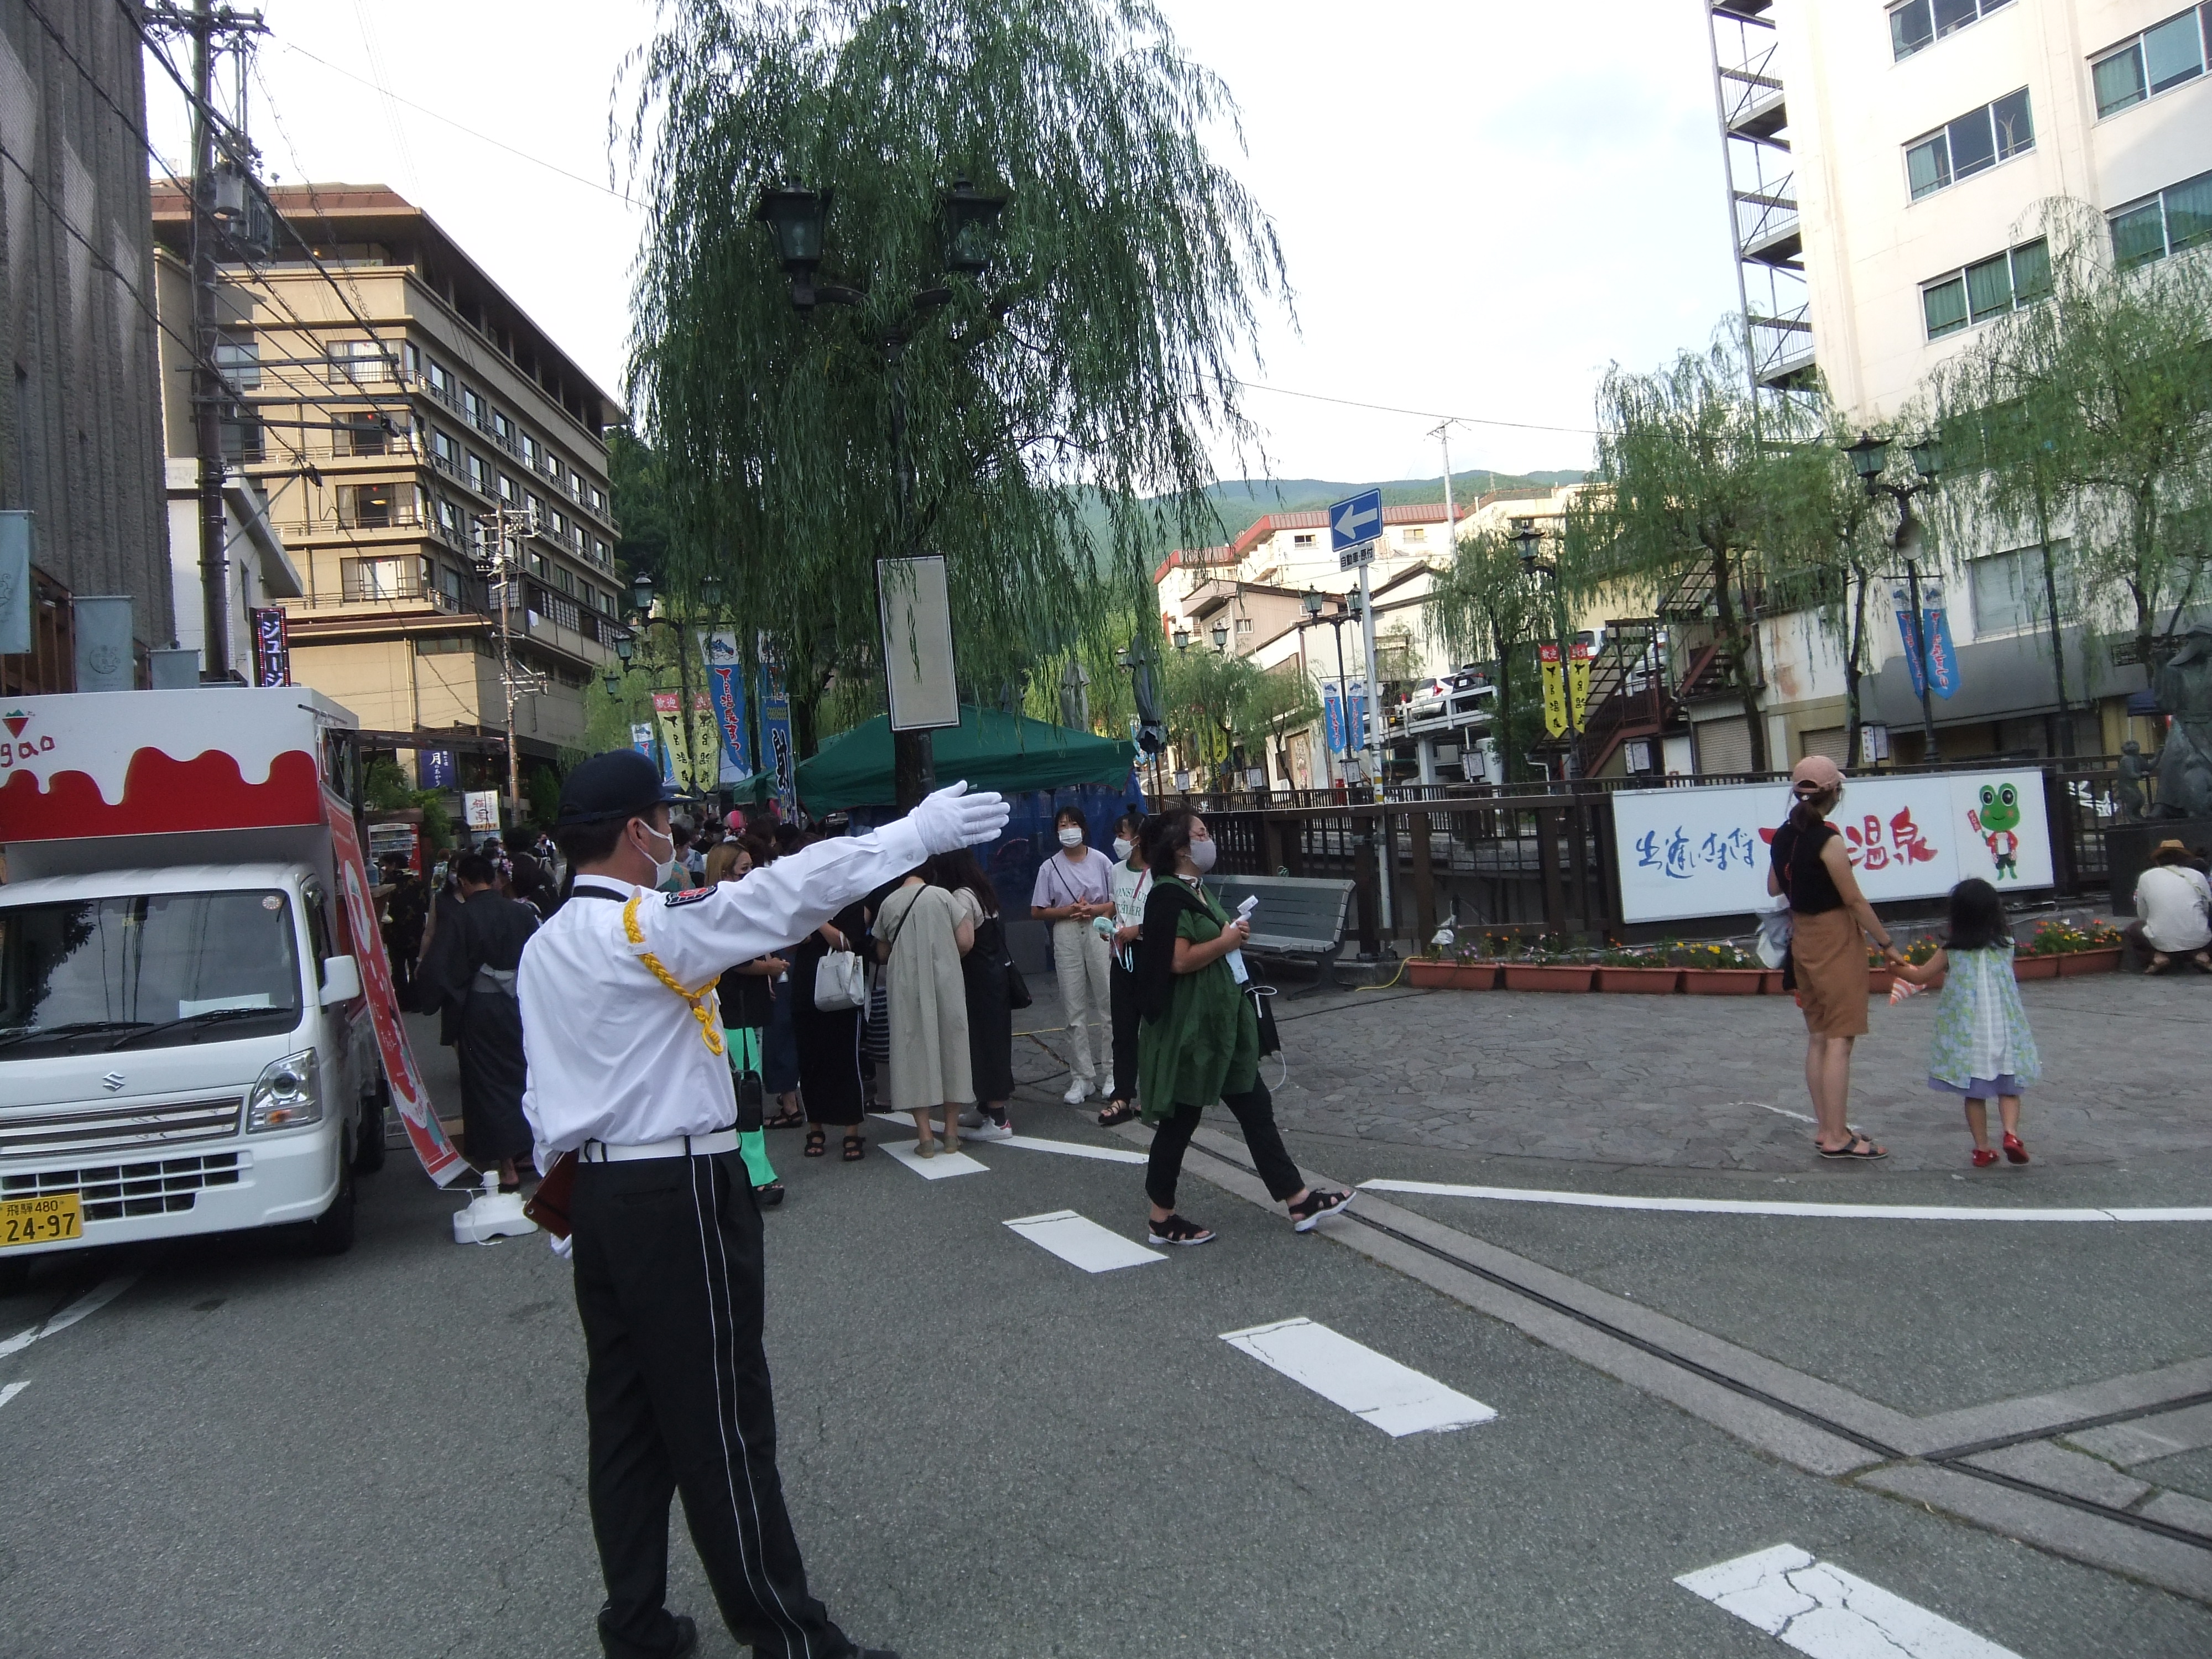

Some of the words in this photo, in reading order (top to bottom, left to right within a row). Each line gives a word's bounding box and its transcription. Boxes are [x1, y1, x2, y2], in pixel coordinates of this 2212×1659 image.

[656, 697, 678, 708] 歓迎
[1546, 666, 1562, 728] 下呂温泉
[664, 715, 691, 782] 下呂温泉
[429, 752, 441, 787] 月のあかり
[35, 1200, 58, 1213] 480
[6, 1212, 75, 1242] 24-97
